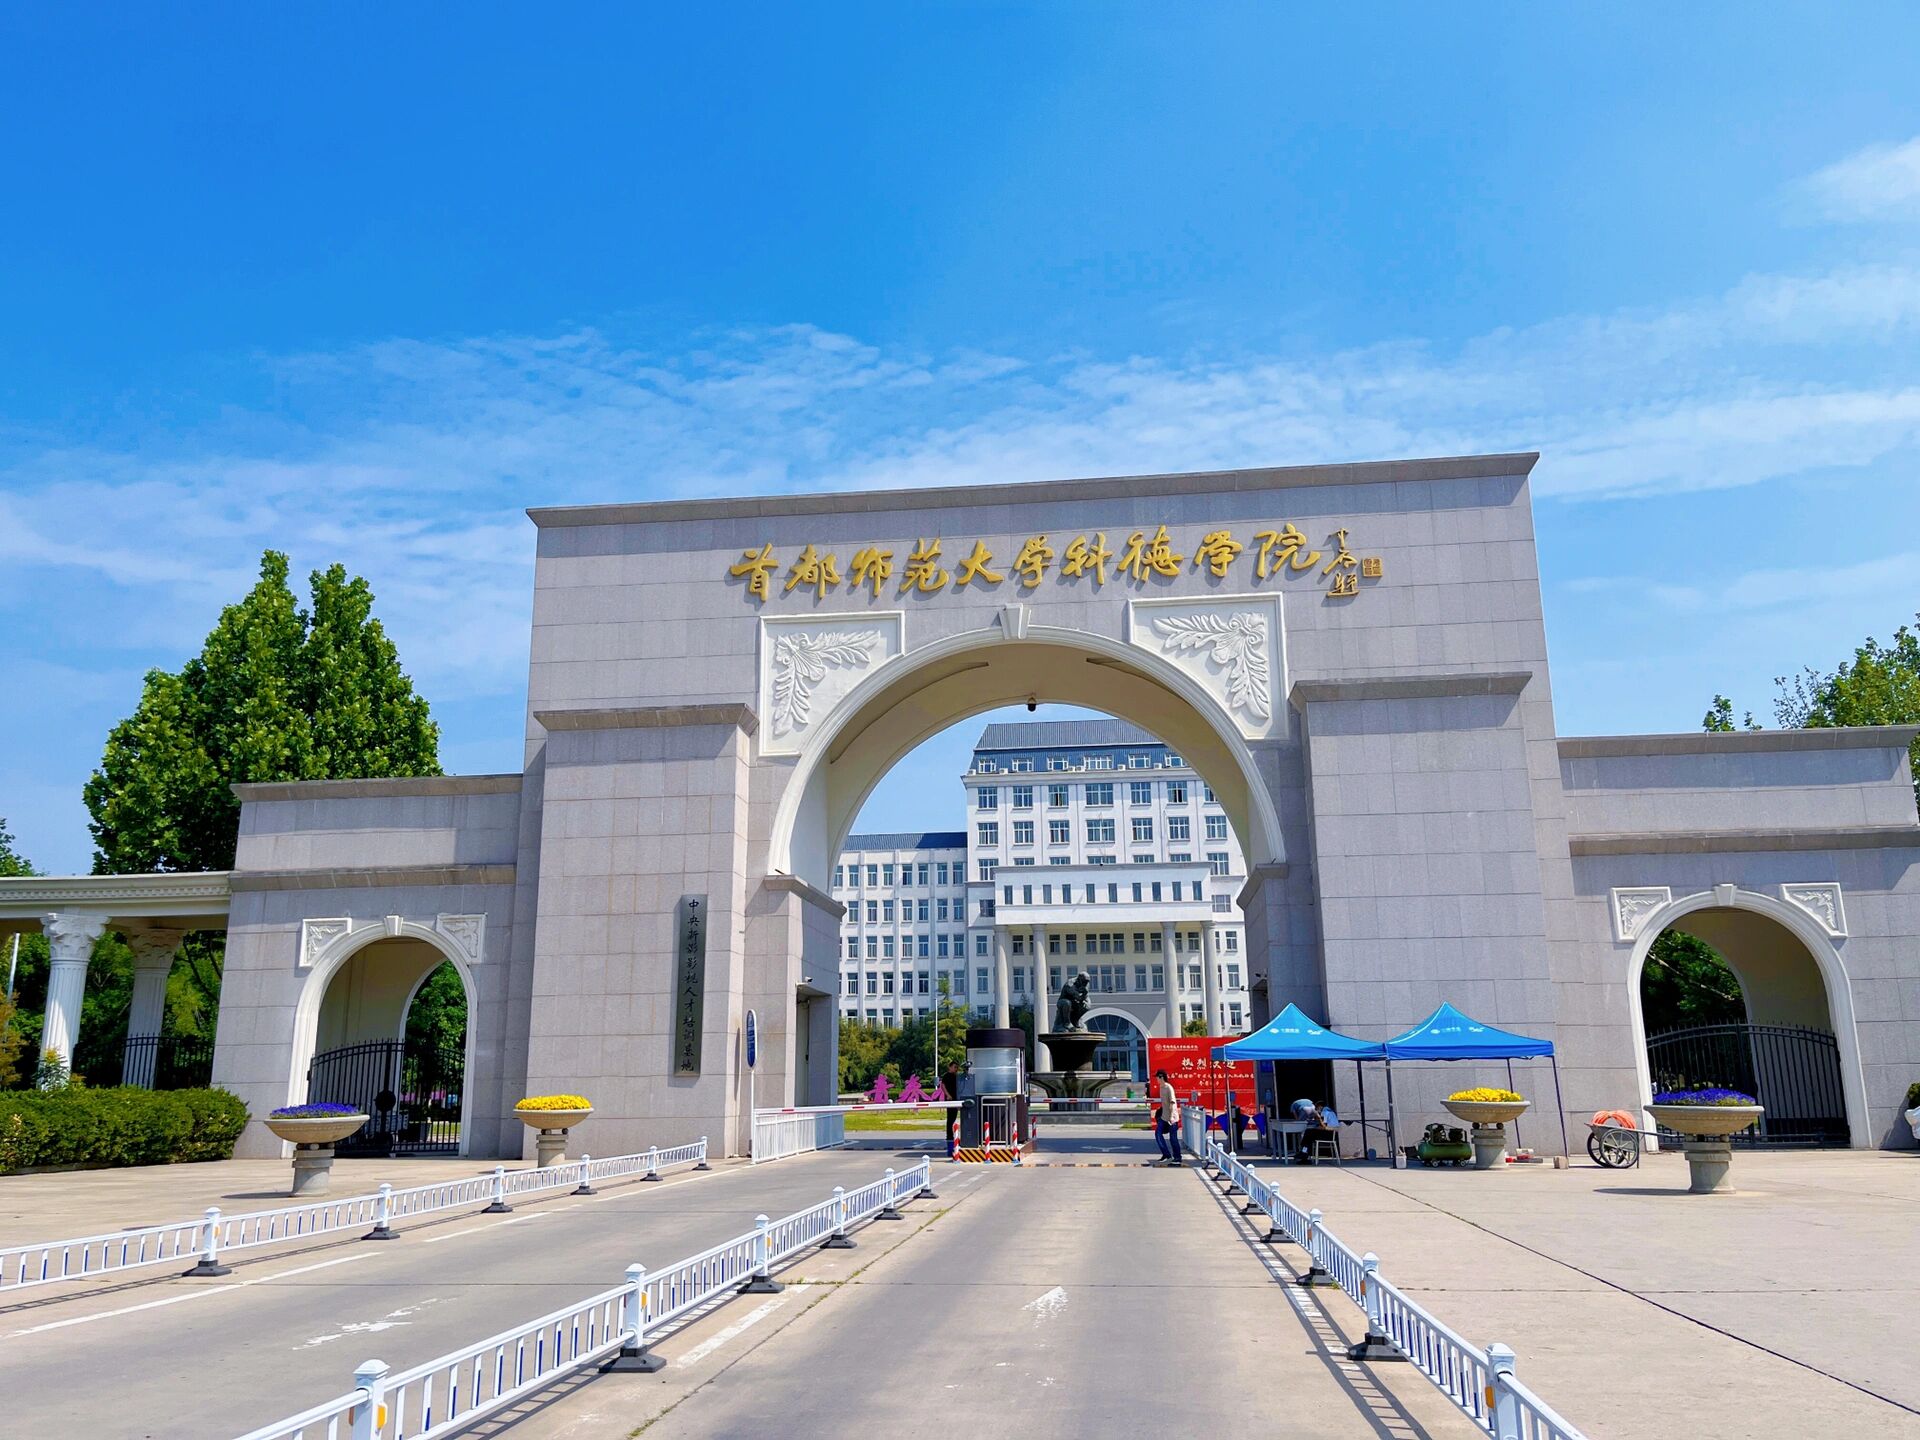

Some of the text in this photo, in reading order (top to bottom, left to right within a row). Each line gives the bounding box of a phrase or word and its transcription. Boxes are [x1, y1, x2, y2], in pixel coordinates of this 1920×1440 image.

[730, 524, 1320, 602] 首都师范大学科德学院
